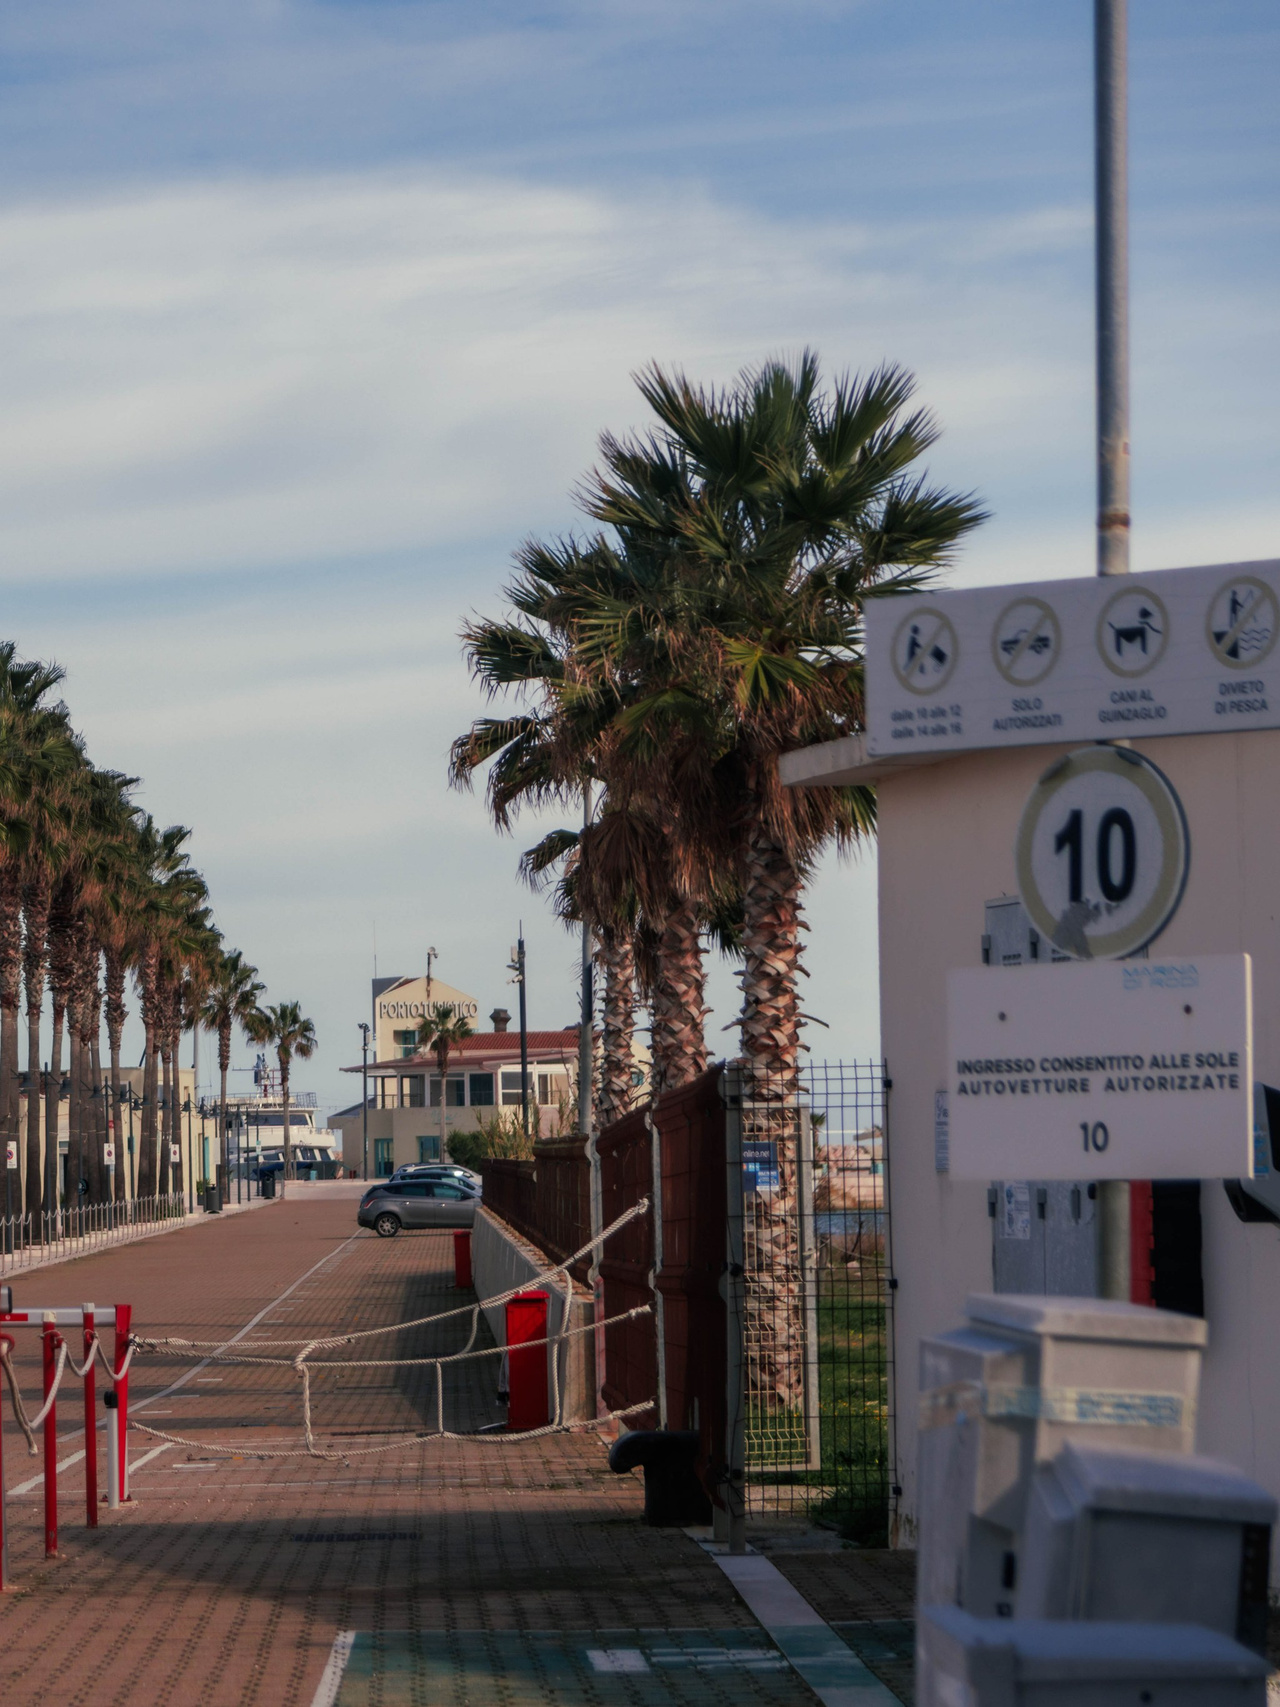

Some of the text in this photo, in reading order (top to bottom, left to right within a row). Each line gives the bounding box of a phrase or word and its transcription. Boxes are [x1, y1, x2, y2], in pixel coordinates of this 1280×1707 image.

[1110, 689, 1154, 704] CANI AL
[1219, 680, 1264, 695] DIVIETO
[1012, 698, 1043, 712] SOLO
[1215, 699, 1268, 714] DI PESCA
[993, 713, 1062, 731] AUTORIZZATI
[1098, 706, 1167, 723] GUINZAGLIO
[1054, 806, 1136, 903] 10
[380, 1001, 419, 1019] PORTO
[957, 1052, 1239, 1075] INGRESSO CONSENTITO ALLE SOLE
[957, 1074, 1239, 1096] AUTOVETTURE AUTORIZZATE
[1079, 1121, 1109, 1152] 10
